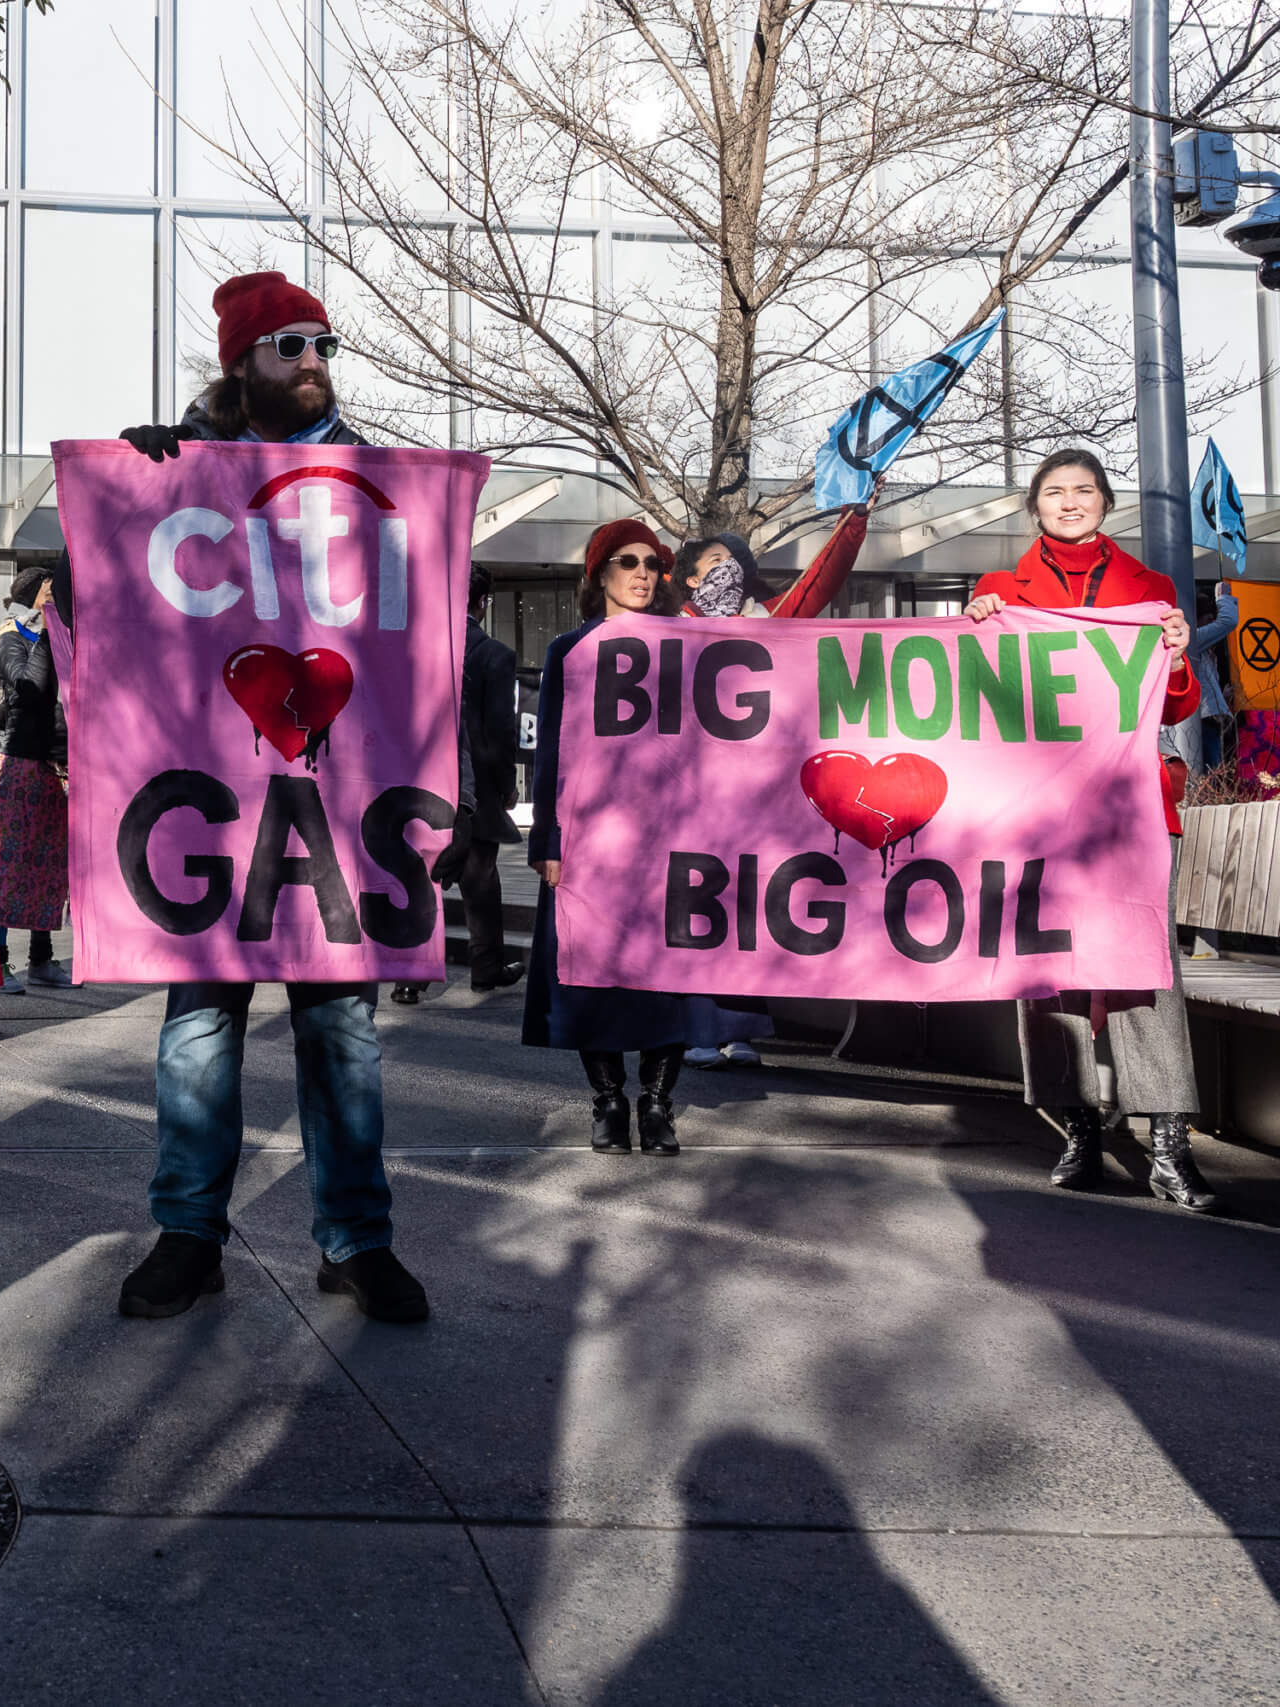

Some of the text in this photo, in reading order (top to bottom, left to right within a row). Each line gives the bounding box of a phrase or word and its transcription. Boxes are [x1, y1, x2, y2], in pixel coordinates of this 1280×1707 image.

[593, 625, 1165, 743] BIG MONEY
[117, 769, 458, 949] GAS
[665, 851, 1073, 964] BIG OIL
